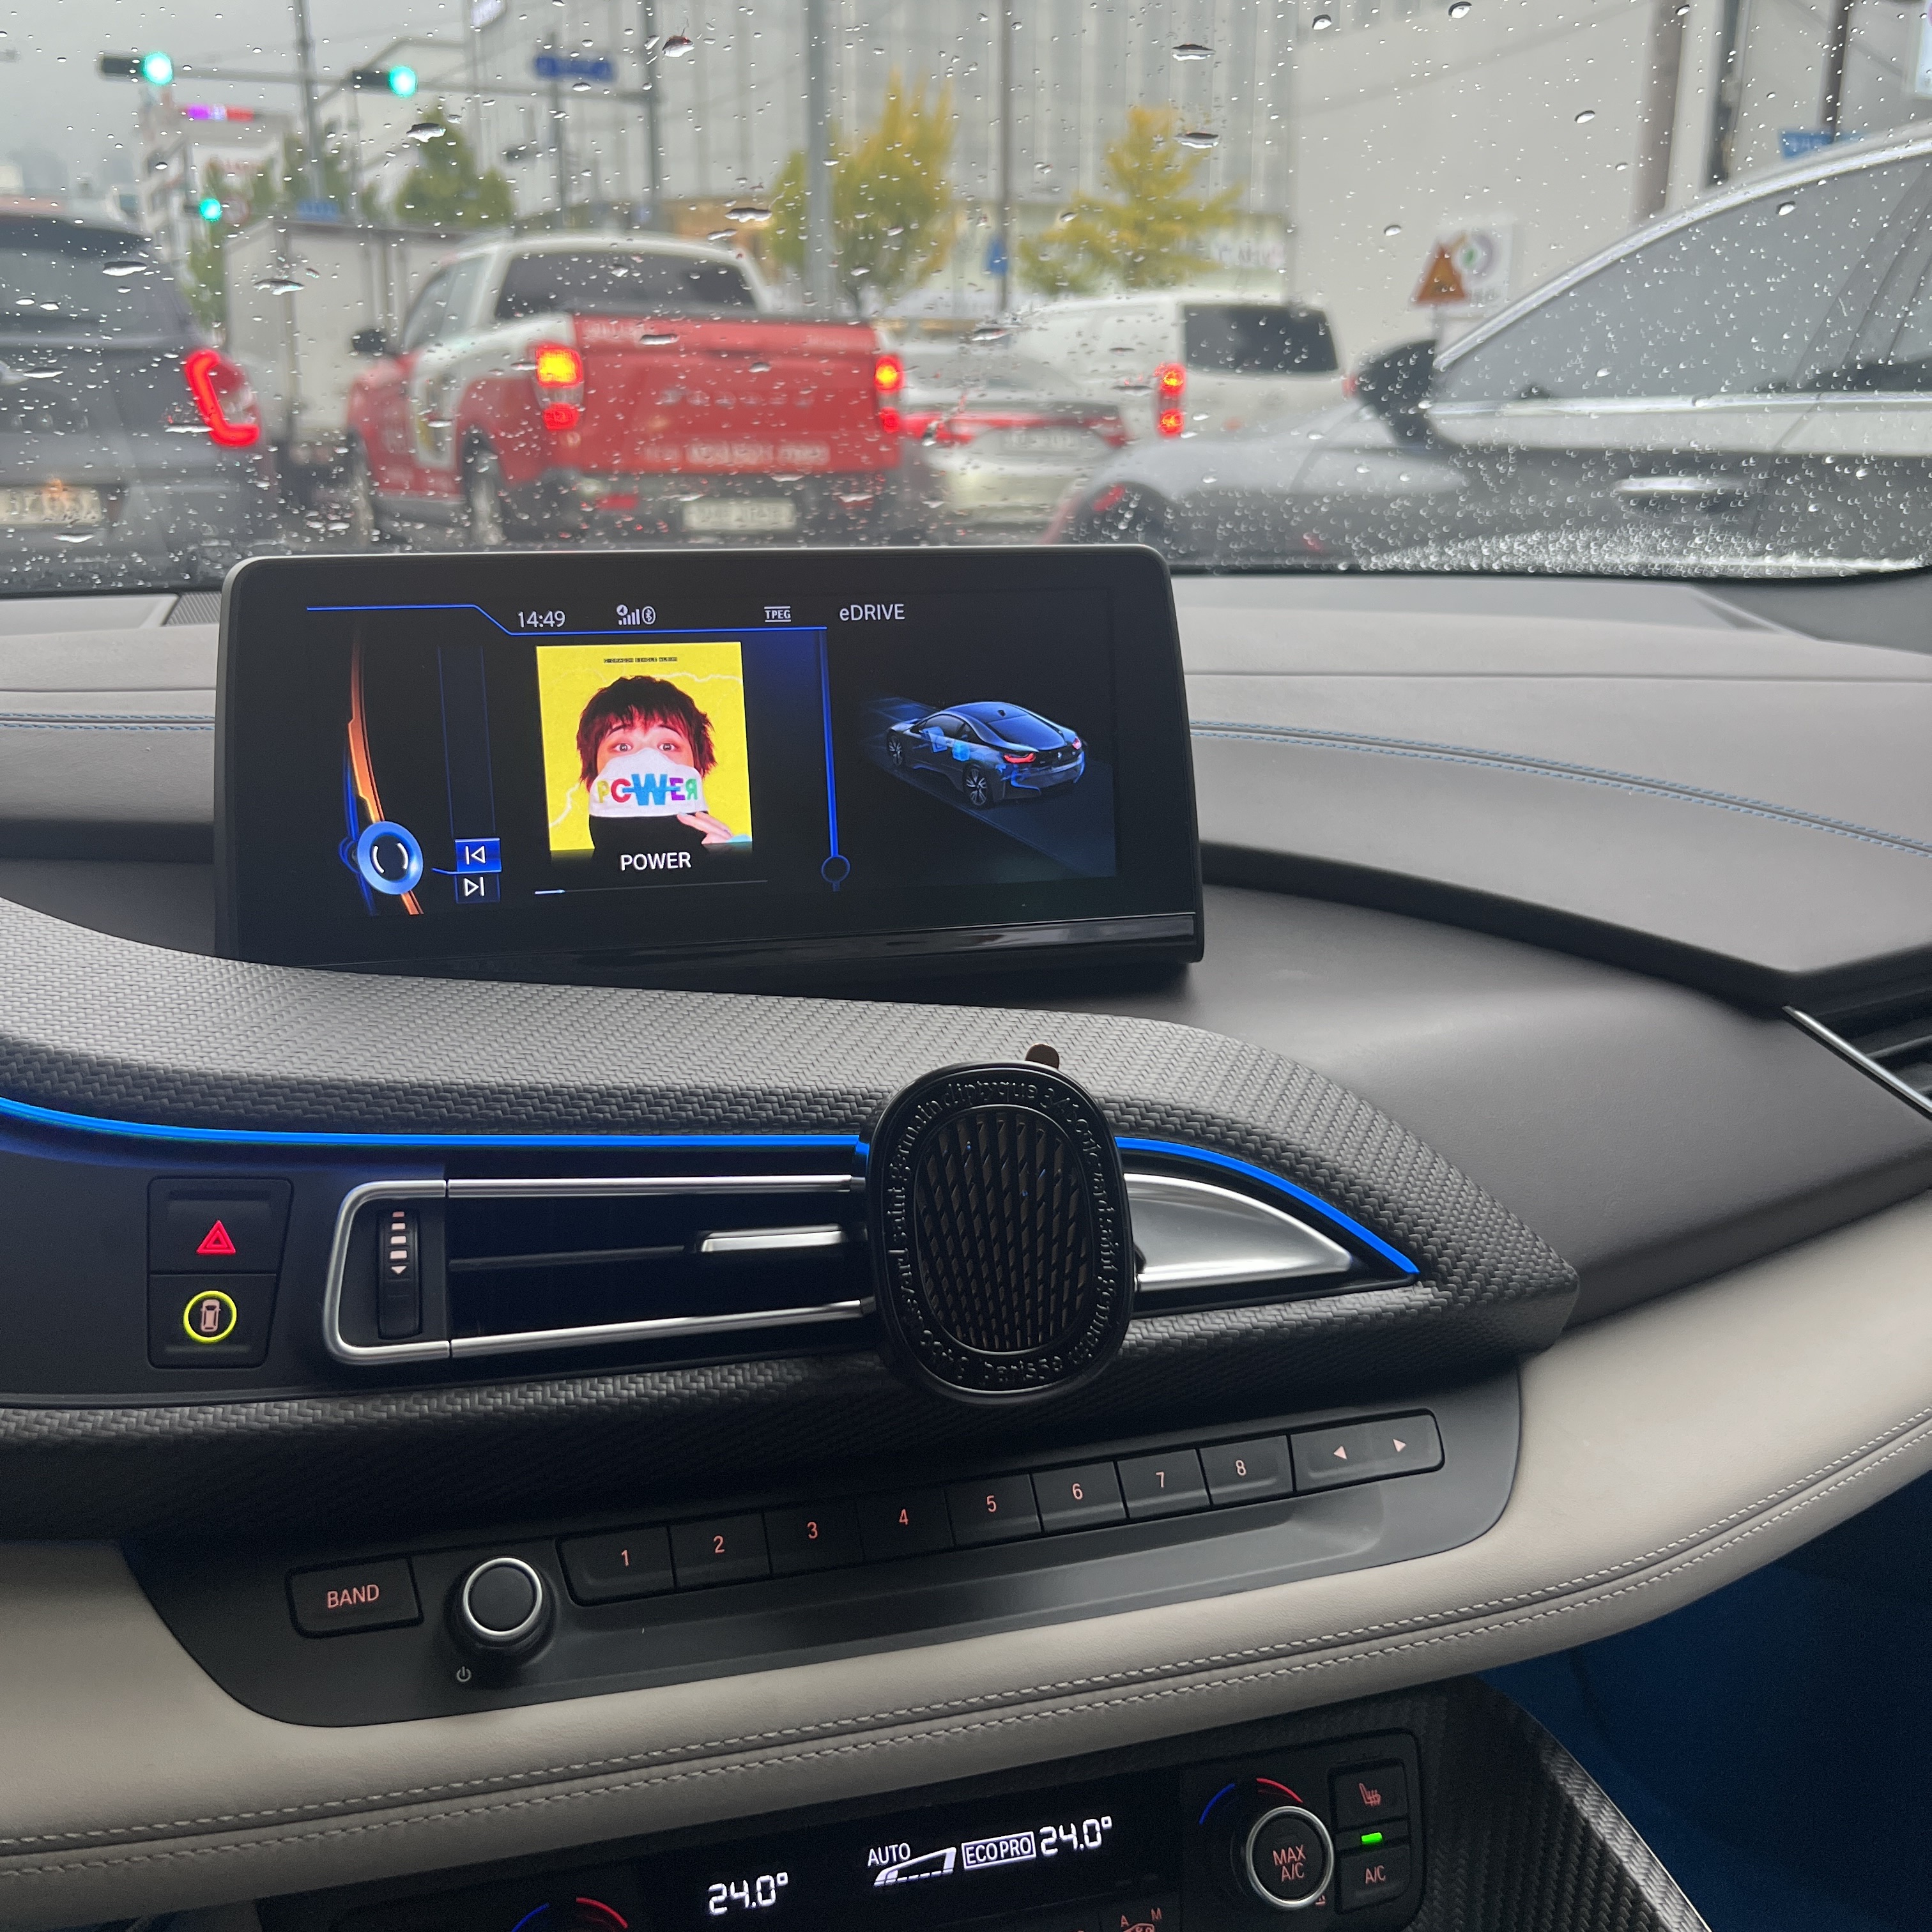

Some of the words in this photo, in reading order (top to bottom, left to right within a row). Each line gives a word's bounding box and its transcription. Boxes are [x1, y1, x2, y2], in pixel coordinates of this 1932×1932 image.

[518, 611, 566, 629] 14:49
[765, 610, 791, 620] TPEG
[839, 604, 905, 622] eDRIVE
[620, 852, 692, 871] POWER
[941, 1080, 1038, 1107] diptyque
[1235, 1459, 1247, 1477] 8
[1155, 1471, 1166, 1489] 7
[1071, 1483, 1084, 1501] 6
[986, 1495, 997, 1513] 5
[898, 1509, 909, 1526] 4
[806, 1521, 818, 1540] 3
[713, 1535, 724, 1554] 2
[620, 1549, 630, 1567] 1
[326, 1584, 380, 1609] BAND
[867, 1843, 911, 1867] AUTO
[965, 1843, 998, 1865] ECO
[999, 1837, 1032, 1859] PRO
[1272, 1845, 1307, 1866] MAX
[1281, 1862, 1305, 1882] A/C
[1365, 1865, 1386, 1884] A/C
